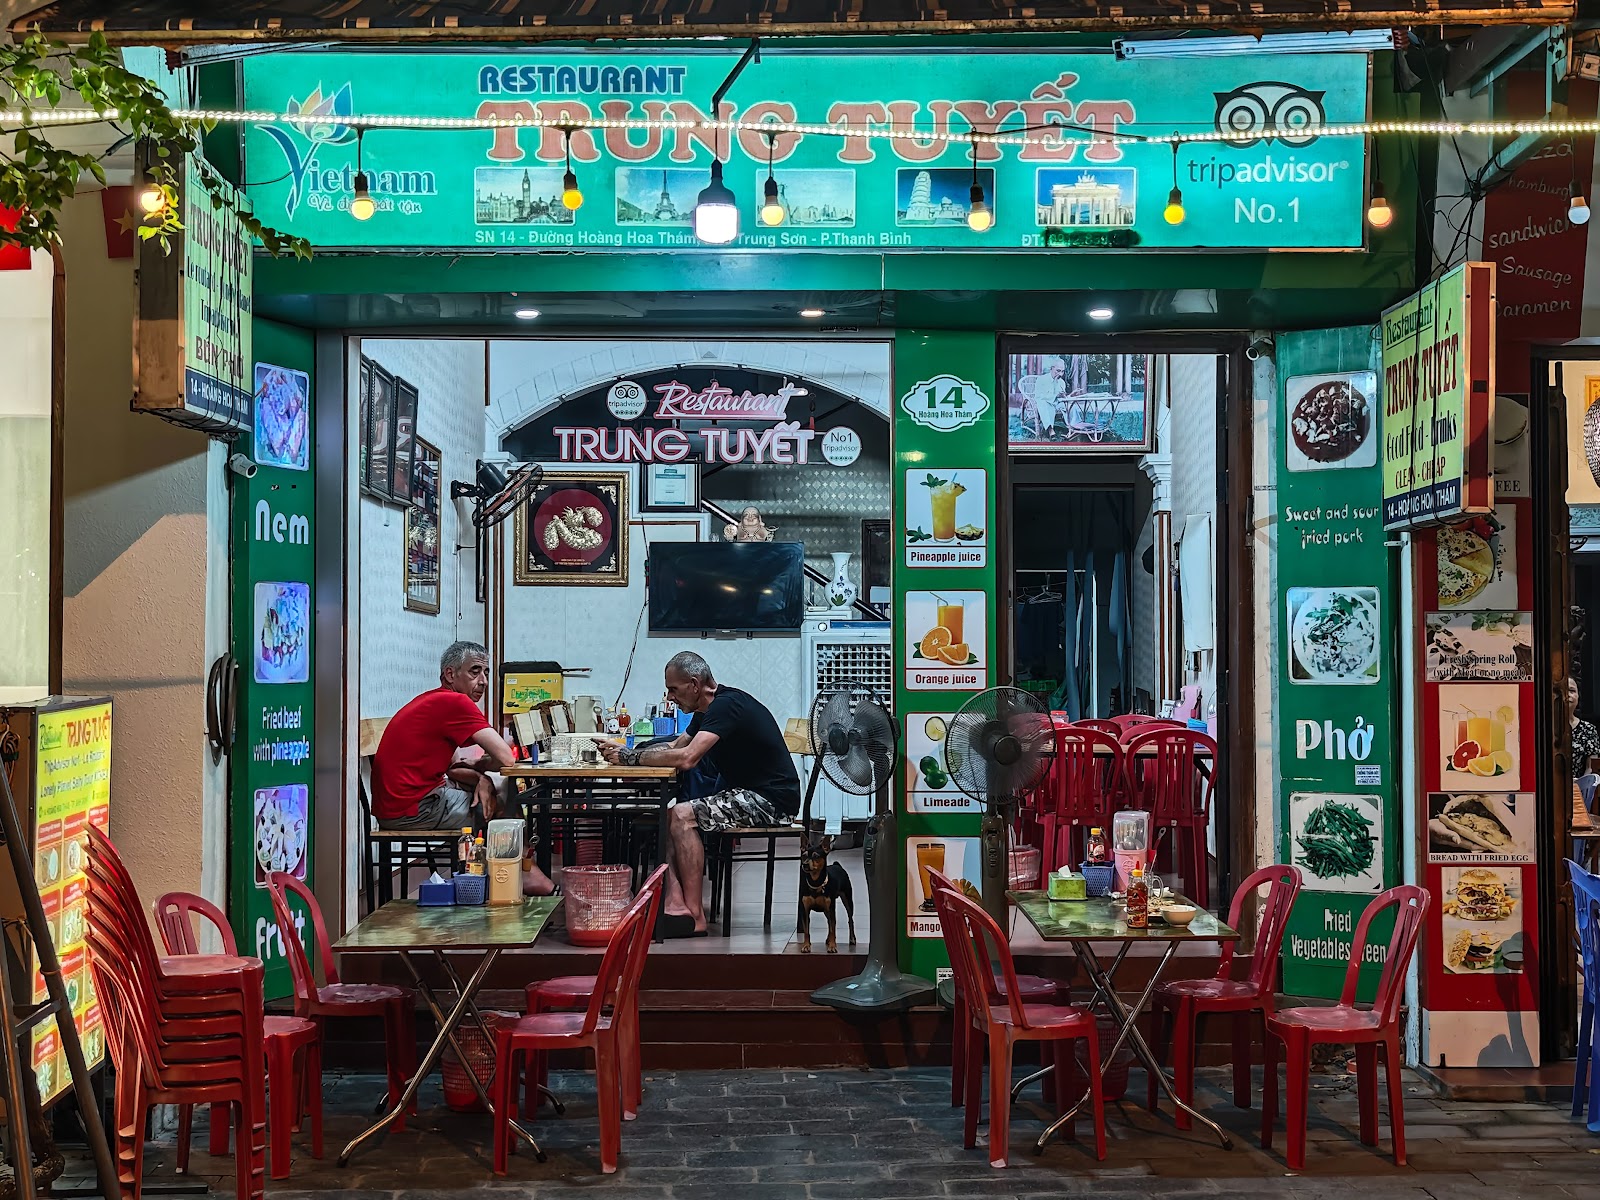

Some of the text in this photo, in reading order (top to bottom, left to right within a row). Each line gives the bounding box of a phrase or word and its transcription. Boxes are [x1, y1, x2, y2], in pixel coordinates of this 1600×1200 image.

[478, 64, 687, 95] RESTAURANT
[475, 71, 1136, 164] TRUNG TUYẾT
[1529, 142, 1573, 160] zza
[1507, 174, 1570, 197] hamburg
[1234, 197, 1299, 224] No.1
[191, 202, 221, 257] TRUNG
[475, 230, 495, 244] SN
[500, 230, 515, 243] 14
[528, 230, 574, 246] Đường
[578, 230, 622, 246] Hoàng
[627, 230, 654, 244] Hoa
[738, 232, 776, 247] Trung
[780, 232, 807, 246] Sơn
[820, 232, 875, 246] P.Thanh
[880, 232, 911, 246] Bình
[1488, 206, 1578, 249] sandwich
[195, 263, 216, 293] routad
[1500, 256, 1572, 288] Sausage
[1386, 299, 1433, 347] Restaurant
[190, 378, 198, 396] 14
[653, 379, 808, 420] Restaurant
[924, 386, 967, 409] 14
[552, 420, 815, 464] TRUNG TUYẾT
[823, 443, 858, 454] Tripadvisor
[830, 432, 852, 443] No1
[1386, 427, 1405, 463] Good
[1405, 420, 1424, 457] Fod
[1421, 456, 1446, 482] CHAP
[1285, 503, 1379, 522] Sweet and sour
[1387, 502, 1395, 520] 14
[1436, 483, 1456, 507] THÁM
[254, 498, 310, 545] Nem
[1334, 527, 1363, 547] pork
[910, 551, 981, 563] Pineapple juice
[1444, 654, 1467, 664] Fresh
[1498, 654, 1515, 664] Roll
[915, 673, 977, 685] Orange juice
[262, 705, 302, 729] Fried beef
[253, 735, 310, 766] with pineapple
[1296, 715, 1375, 761] Phở
[923, 797, 970, 807] Limeade
[1430, 853, 1529, 862] BREAD WITH FRIED EGG
[910, 921, 941, 933] Mango
[1291, 934, 1351, 961] Vegetables
